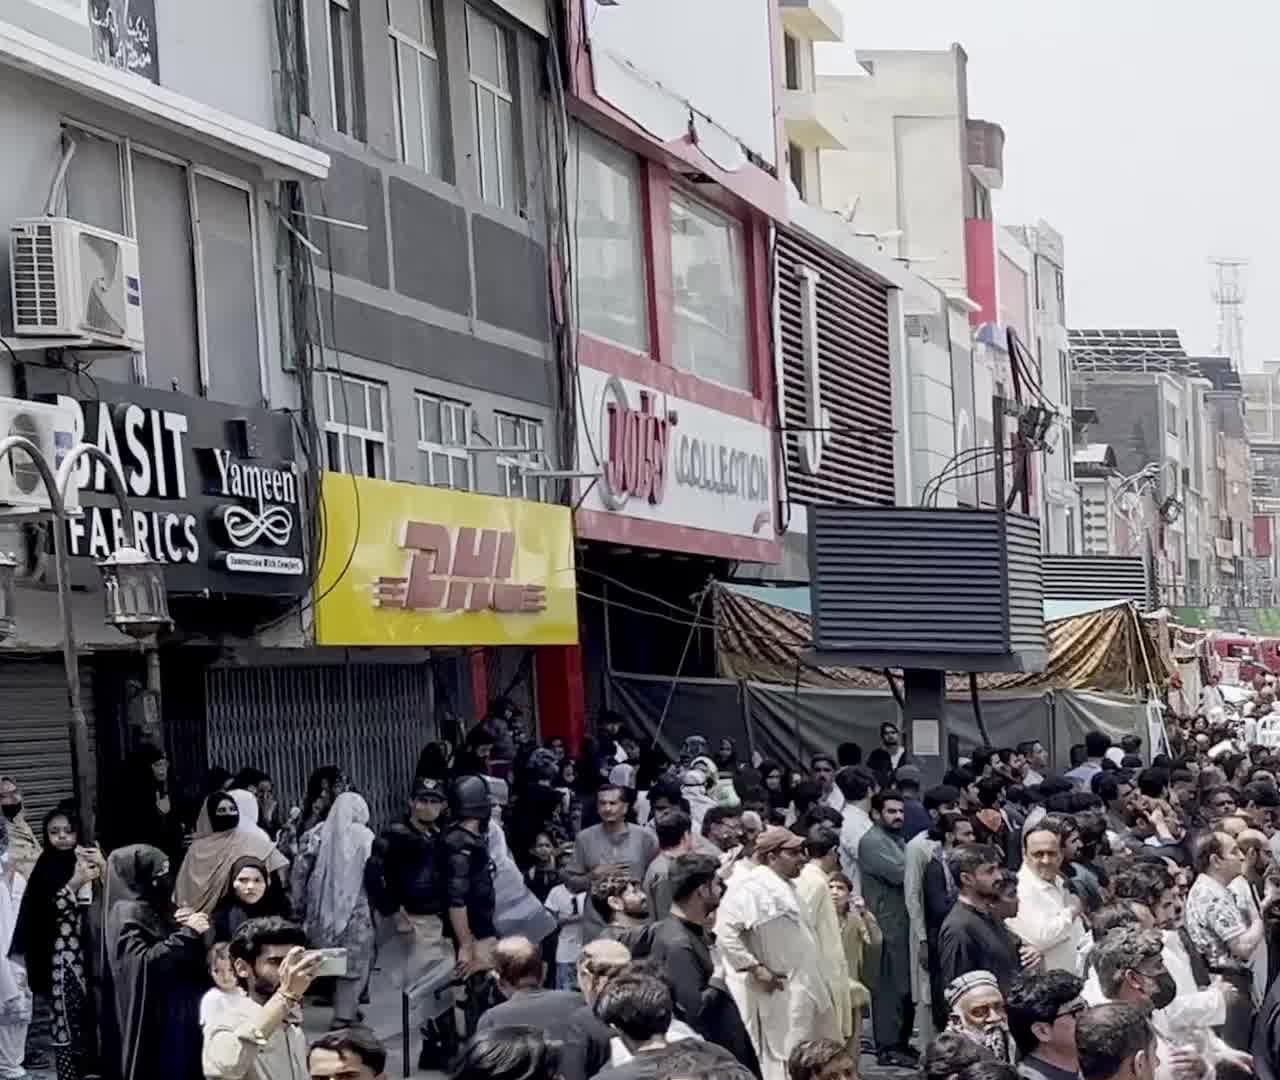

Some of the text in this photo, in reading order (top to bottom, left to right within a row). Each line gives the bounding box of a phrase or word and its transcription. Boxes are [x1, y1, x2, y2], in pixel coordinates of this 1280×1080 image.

[57, 394, 188, 499] BASIT
[213, 448, 297, 506] Yameen
[68, 506, 200, 563] FABRICS
[373, 520, 546, 613] DHL
